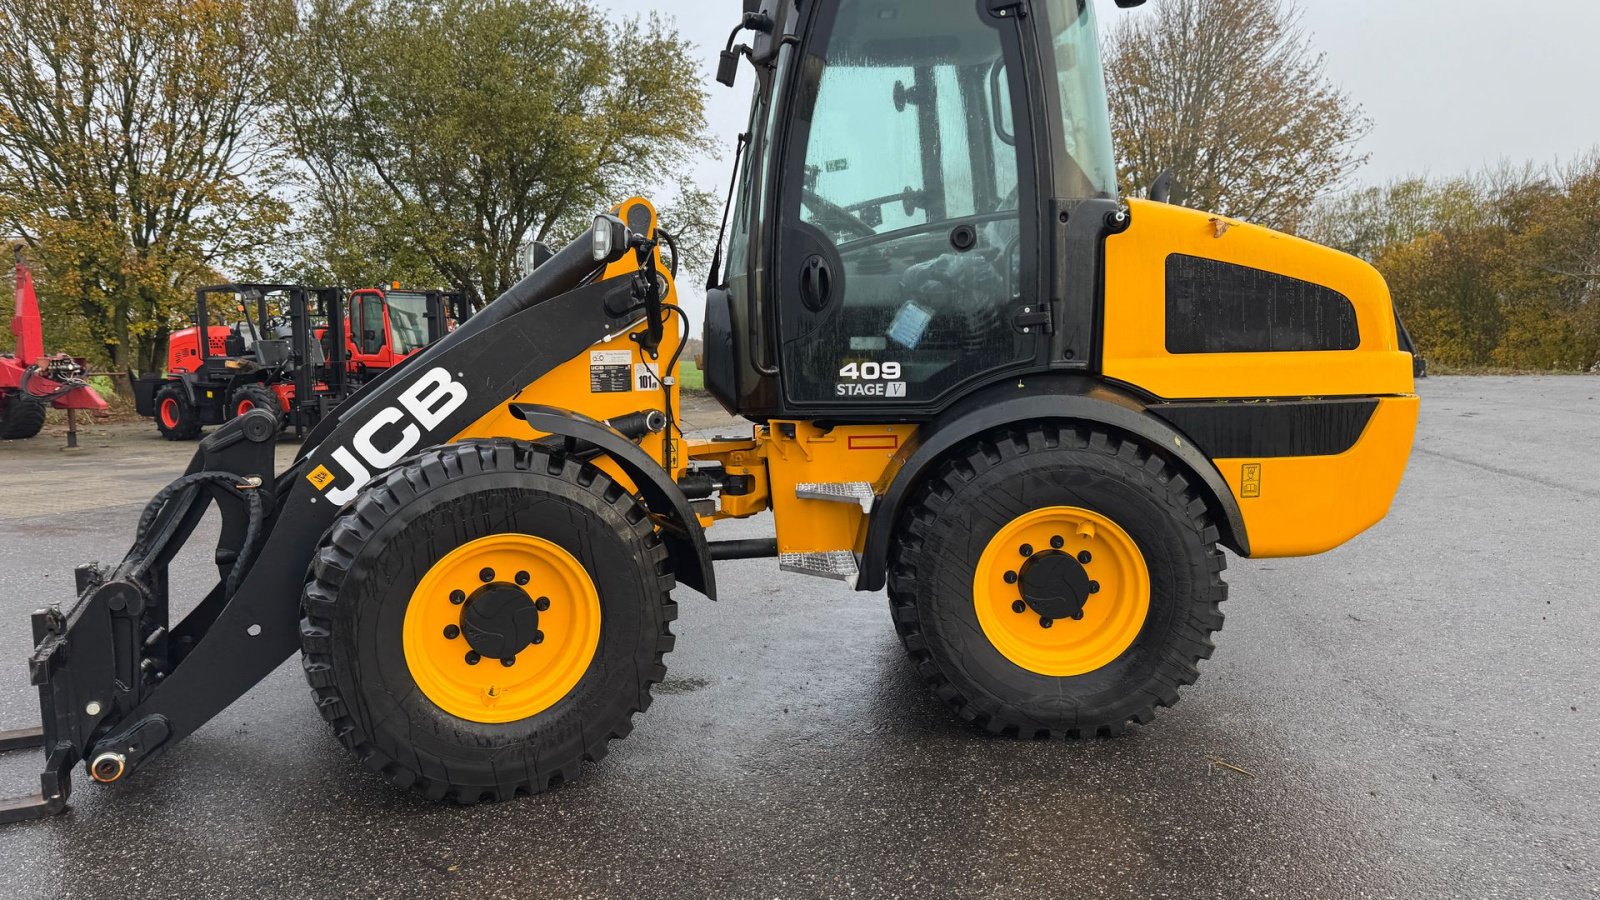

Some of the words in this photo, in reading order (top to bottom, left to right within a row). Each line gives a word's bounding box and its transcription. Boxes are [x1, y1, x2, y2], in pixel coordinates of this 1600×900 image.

[839, 361, 901, 380] 409
[639, 375, 652, 389] 101
[836, 383, 885, 396] STAGE
[324, 366, 469, 507] JCB
